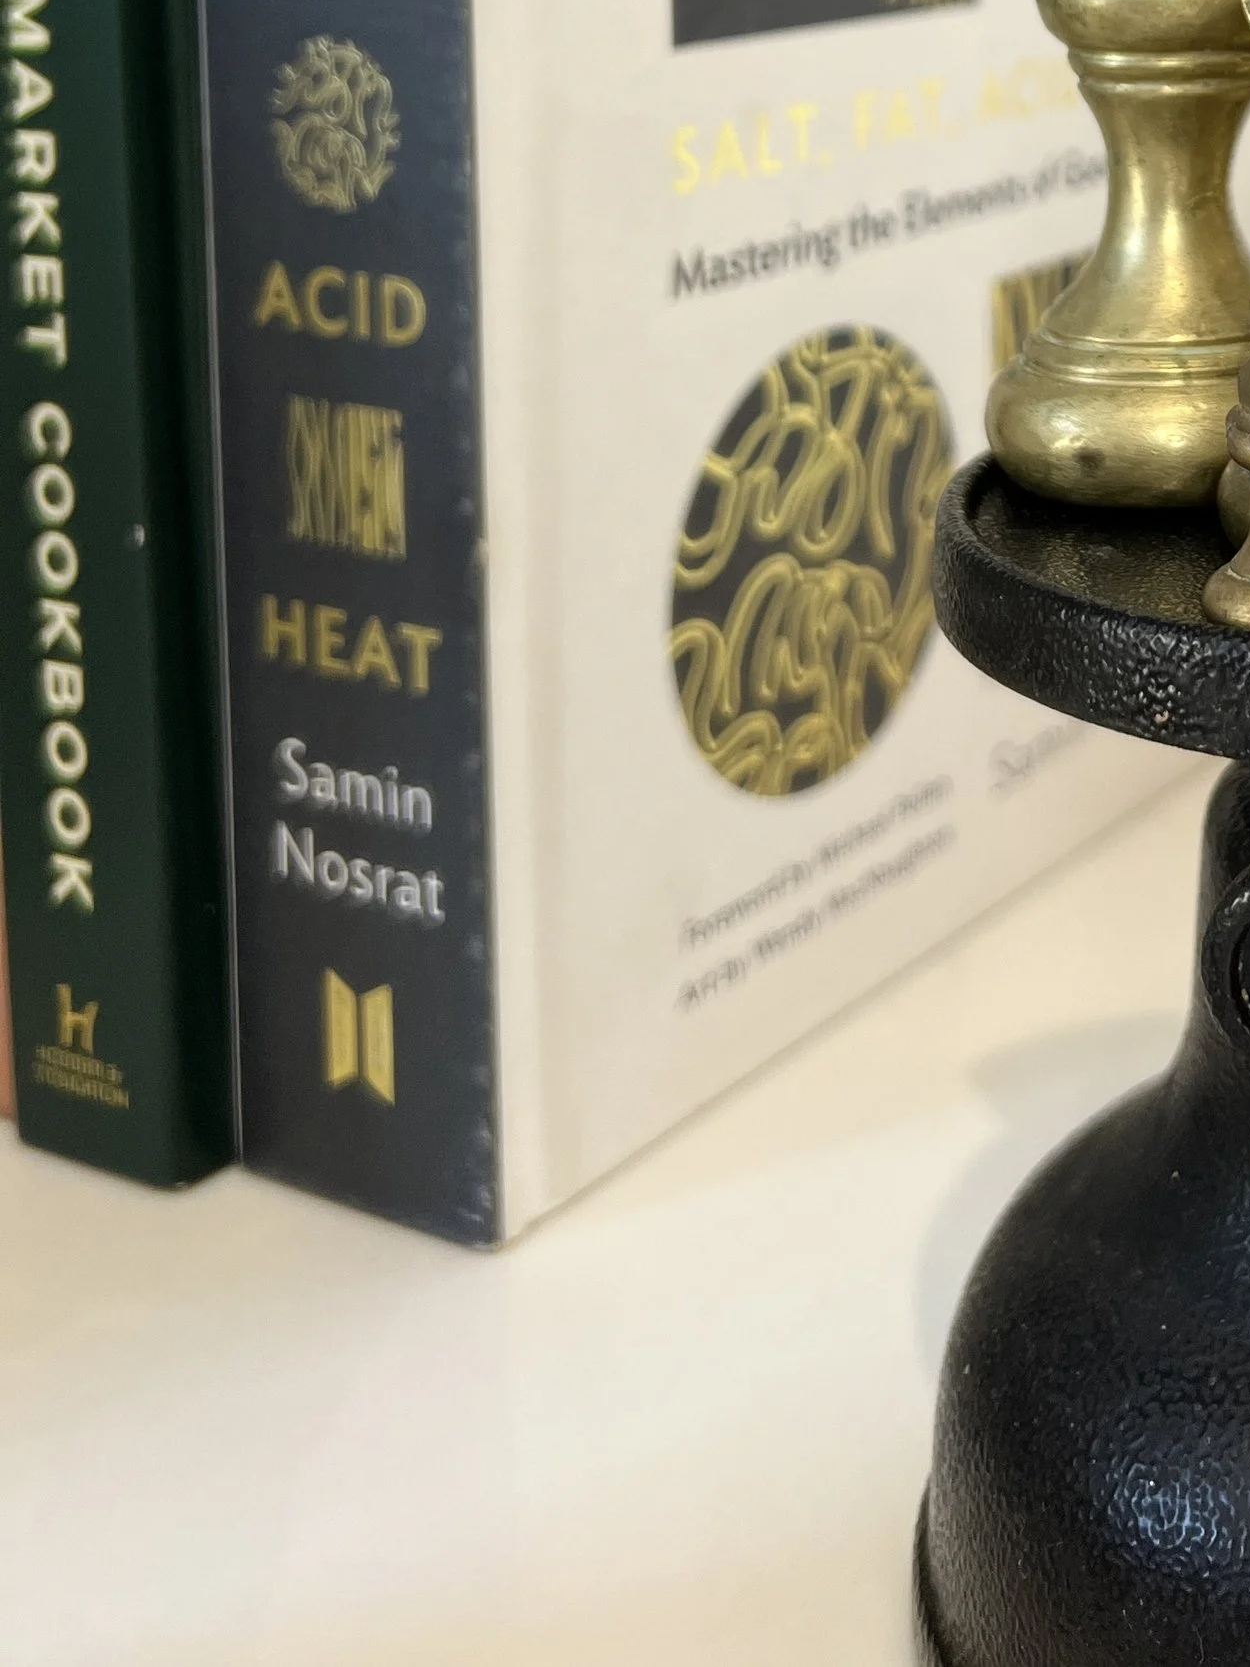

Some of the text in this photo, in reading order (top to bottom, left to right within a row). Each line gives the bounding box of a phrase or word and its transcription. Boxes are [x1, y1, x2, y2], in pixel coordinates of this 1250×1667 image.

[671, 218, 841, 301] Mastering
[847, 200, 899, 252] the
[255, 259, 427, 348] ACID
[26, 400, 94, 914] COOKBOOK
[258, 592, 443, 699] HEAT
[273, 737, 433, 834] Samin
[271, 818, 446, 926] Nosrat
